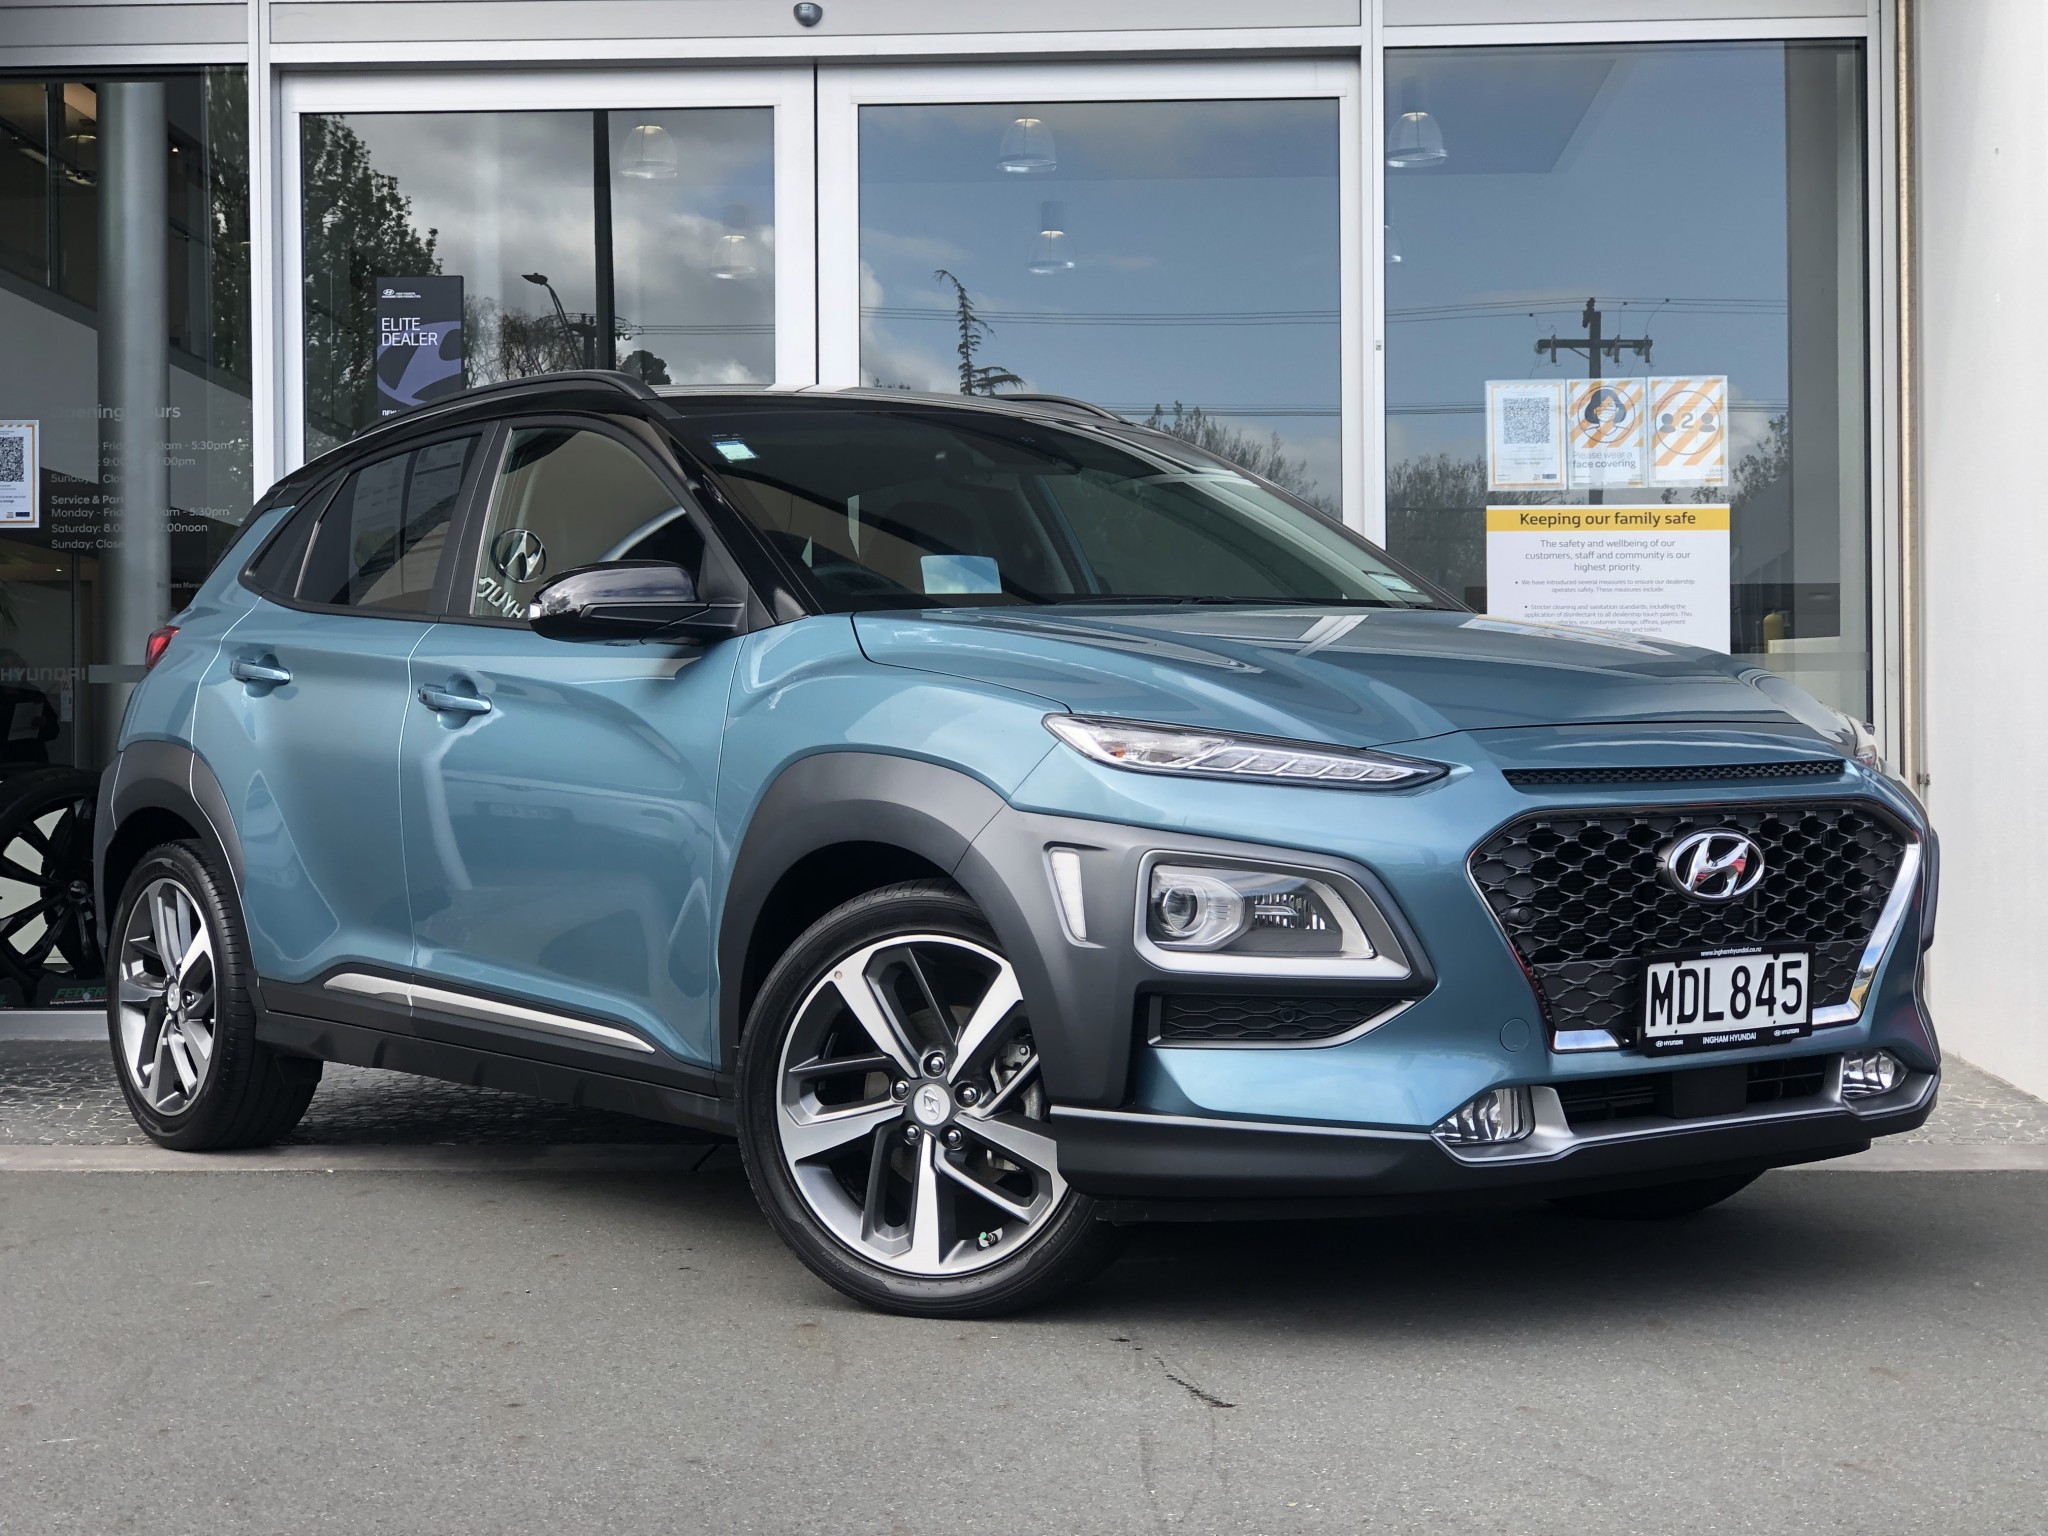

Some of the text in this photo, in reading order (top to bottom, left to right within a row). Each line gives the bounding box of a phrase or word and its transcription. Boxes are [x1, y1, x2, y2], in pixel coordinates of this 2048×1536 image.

[381, 317, 421, 331] ELITE
[381, 332, 438, 346] DEALER
[1681, 412, 1693, 428] 2
[1573, 451, 1602, 460] Please
[1604, 452, 1627, 460] wear
[1573, 459, 1636, 469] face covering
[51, 495, 90, 505] Service
[92, 495, 100, 505] &
[51, 508, 94, 519] Monday
[1520, 511, 1696, 528] Keeping our family safe
[51, 523, 101, 534] Saturday:
[51, 539, 94, 550] Sunday:
[1540, 539, 1676, 550] The safety and wellbeing of our
[1525, 552, 1573, 560] customers,
[1575, 551, 1595, 560] staff
[1596, 551, 1614, 560] and
[1615, 551, 1665, 561] community
[1667, 551, 1674, 559] is
[1574, 563, 1642, 573] highest priority.
[1665, 578, 1696, 586] dealership
[1552, 604, 1577, 612] cleaning
[1619, 603, 1648, 611] standards,
[1649, 603, 1676, 611] including
[1612, 611, 1642, 619] dealership
[1660, 619, 1686, 627] payment
[0, 666, 87, 682] HYUNDAI
[1700, 946, 1763, 957] www.inghamhyundai.co.nz
[1650, 959, 1803, 1027] MDL845
[1663, 1039, 1684, 1047] HYUNDAI
[1702, 1031, 1757, 1045] INGHAM HYUNDAI
